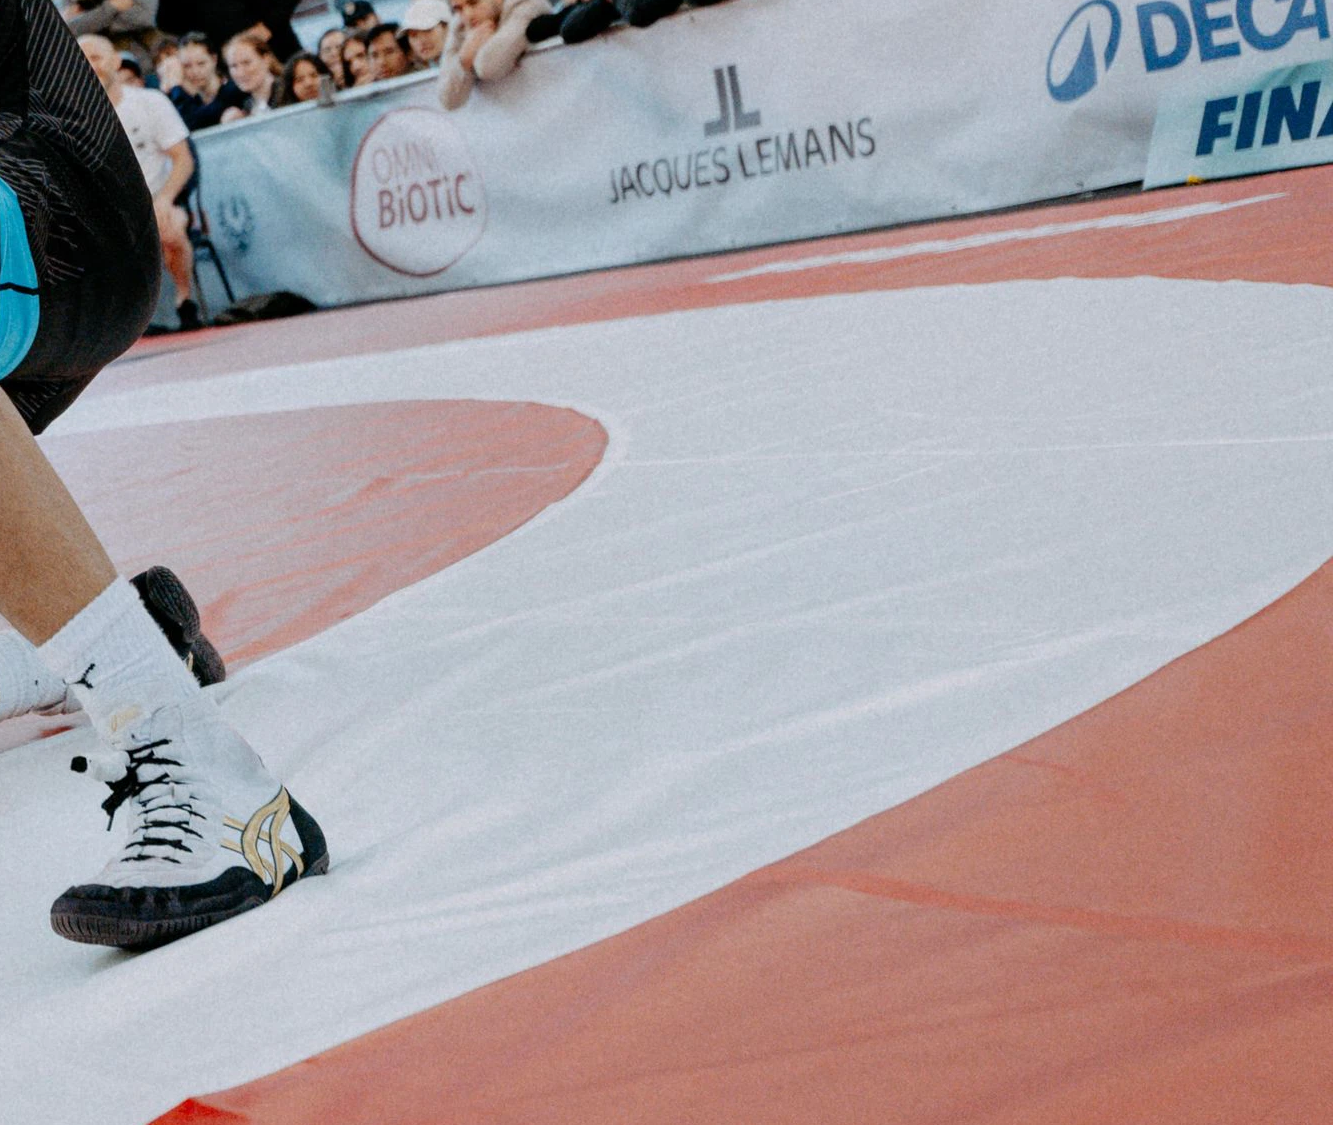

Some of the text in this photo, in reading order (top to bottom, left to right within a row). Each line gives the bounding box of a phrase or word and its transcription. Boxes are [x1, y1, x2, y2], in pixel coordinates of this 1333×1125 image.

[1195, 79, 1333, 157] FIN
[609, 117, 876, 204] JACQUES LEMANS
